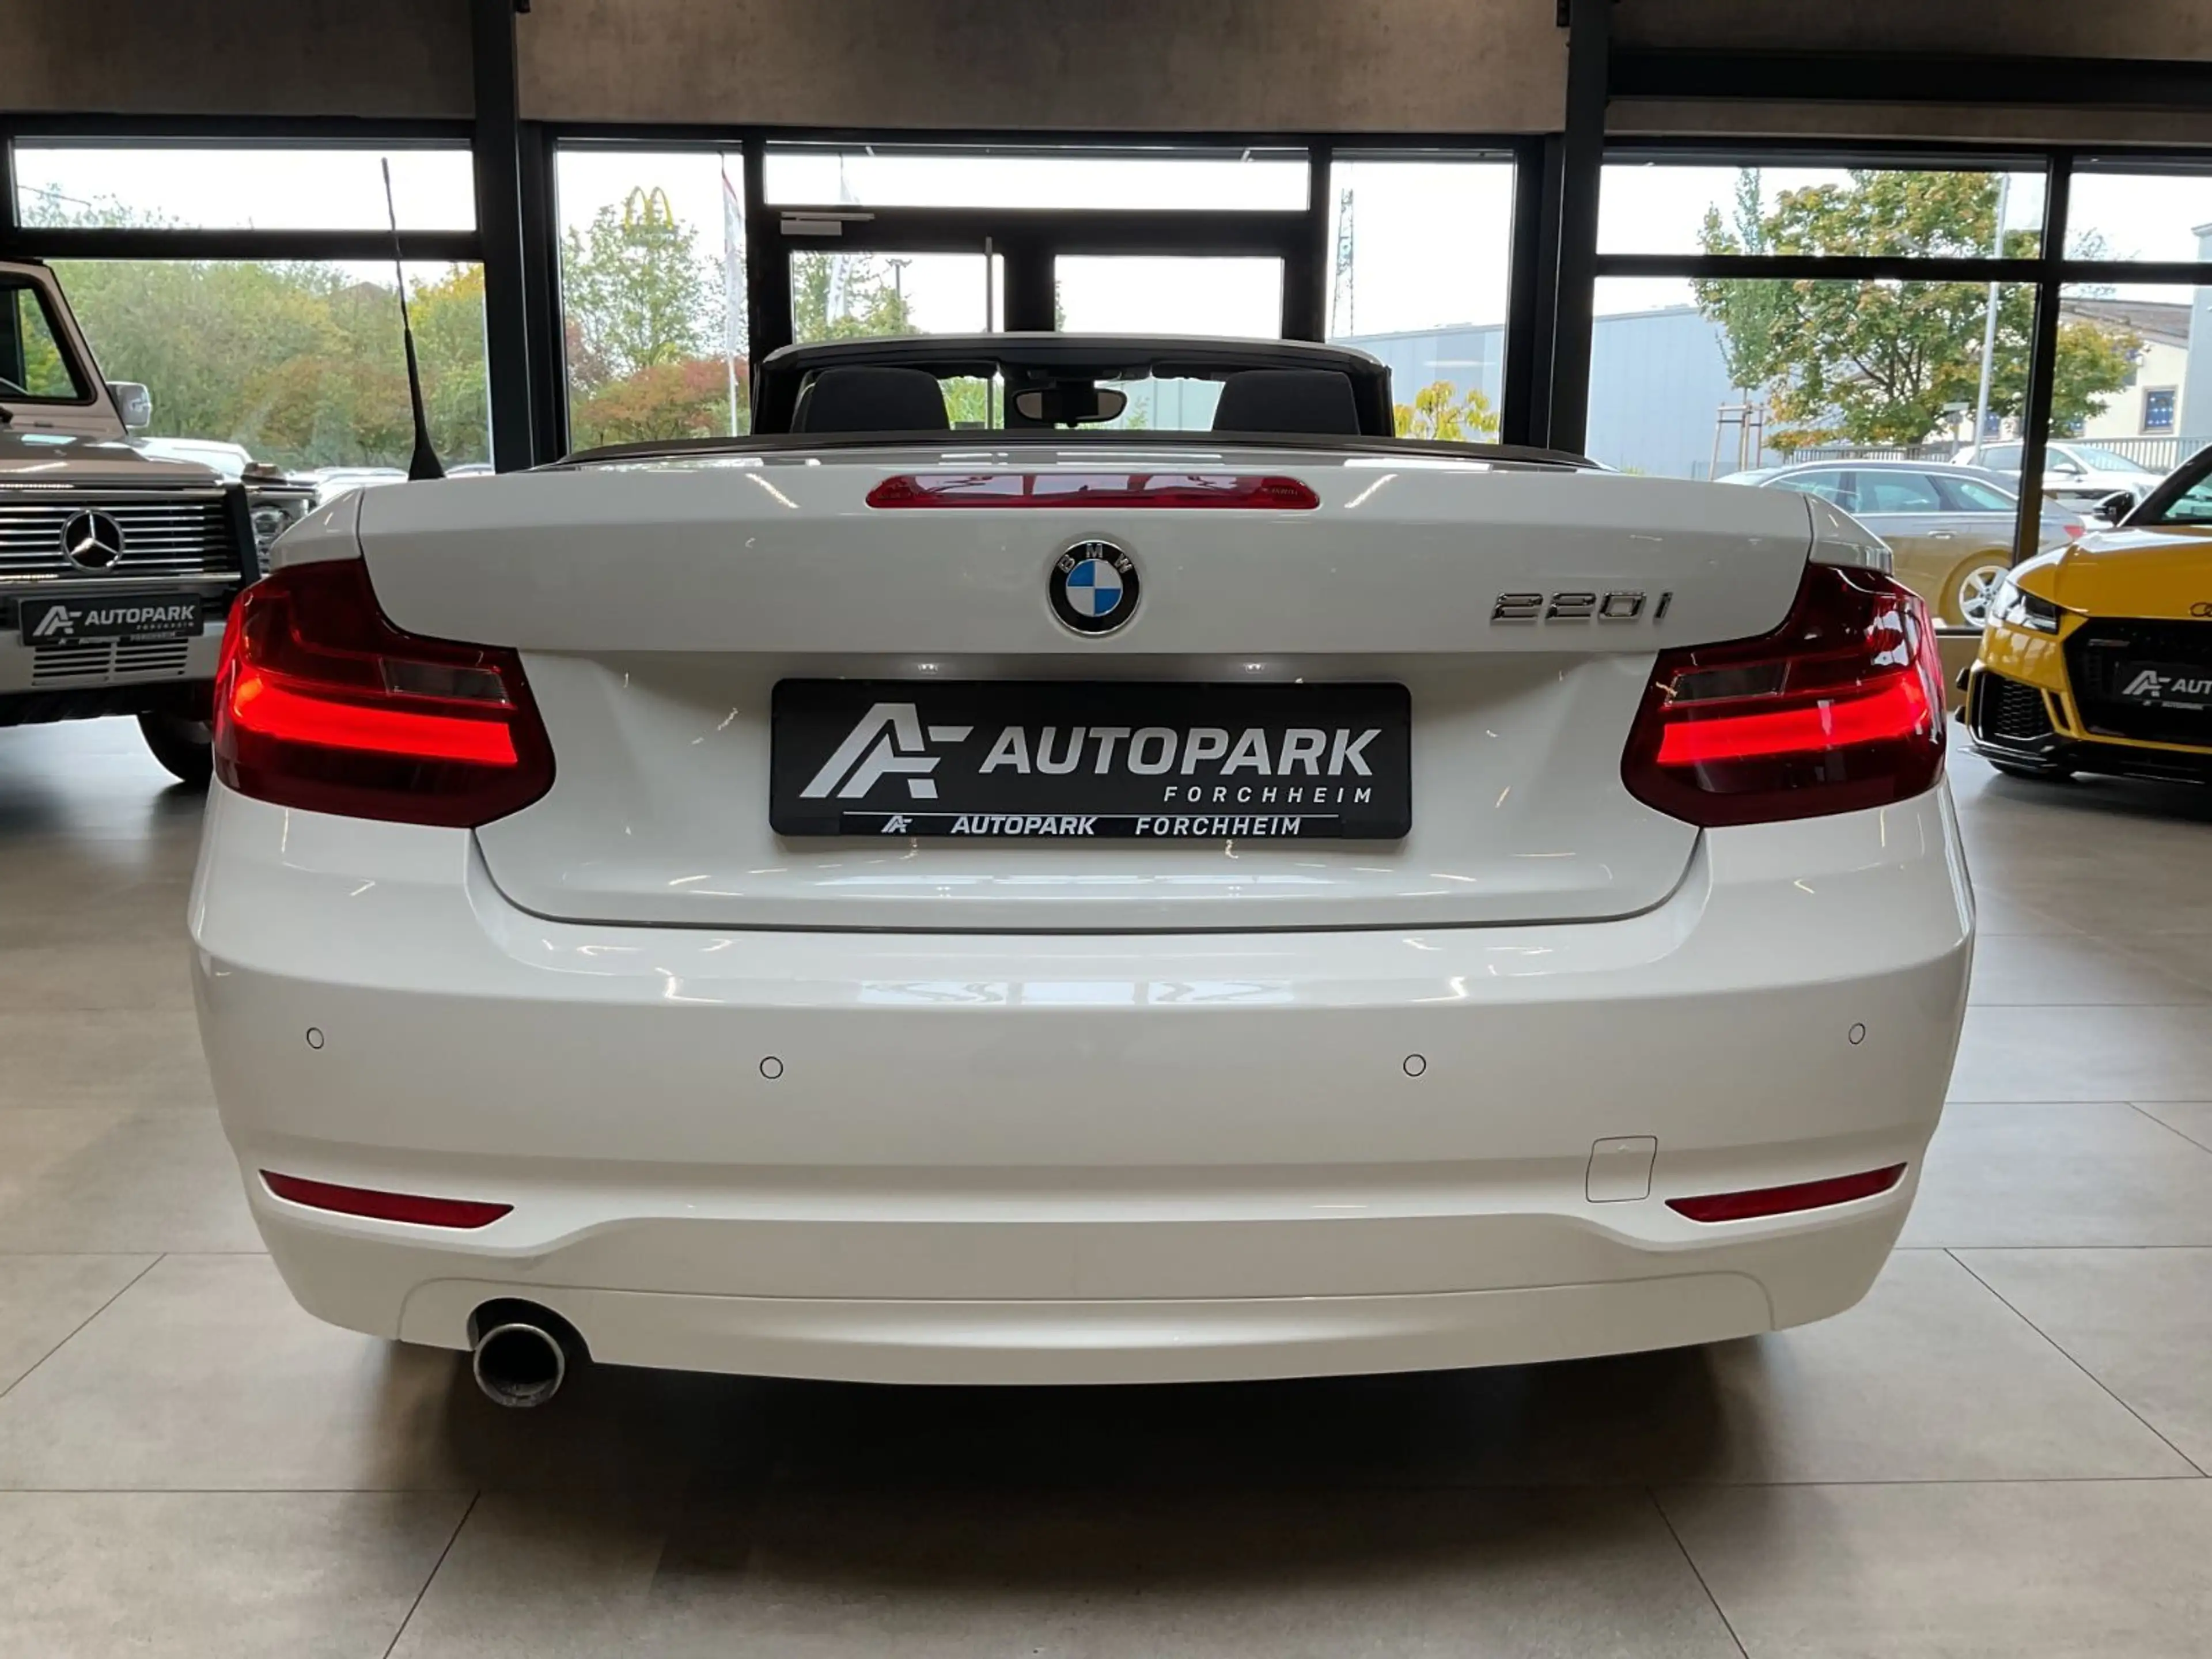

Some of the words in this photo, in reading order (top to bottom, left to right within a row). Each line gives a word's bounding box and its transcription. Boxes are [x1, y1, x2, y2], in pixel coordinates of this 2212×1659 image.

[1058, 543, 1132, 574] BMW
[85, 605, 196, 626] AUTOPARK
[978, 726, 1382, 776] AUTOPARK
[1164, 786, 1372, 804] FORCHHEIM
[950, 815, 1099, 835] AUTOPARK
[1135, 817, 1301, 836] FORCHHEIM
